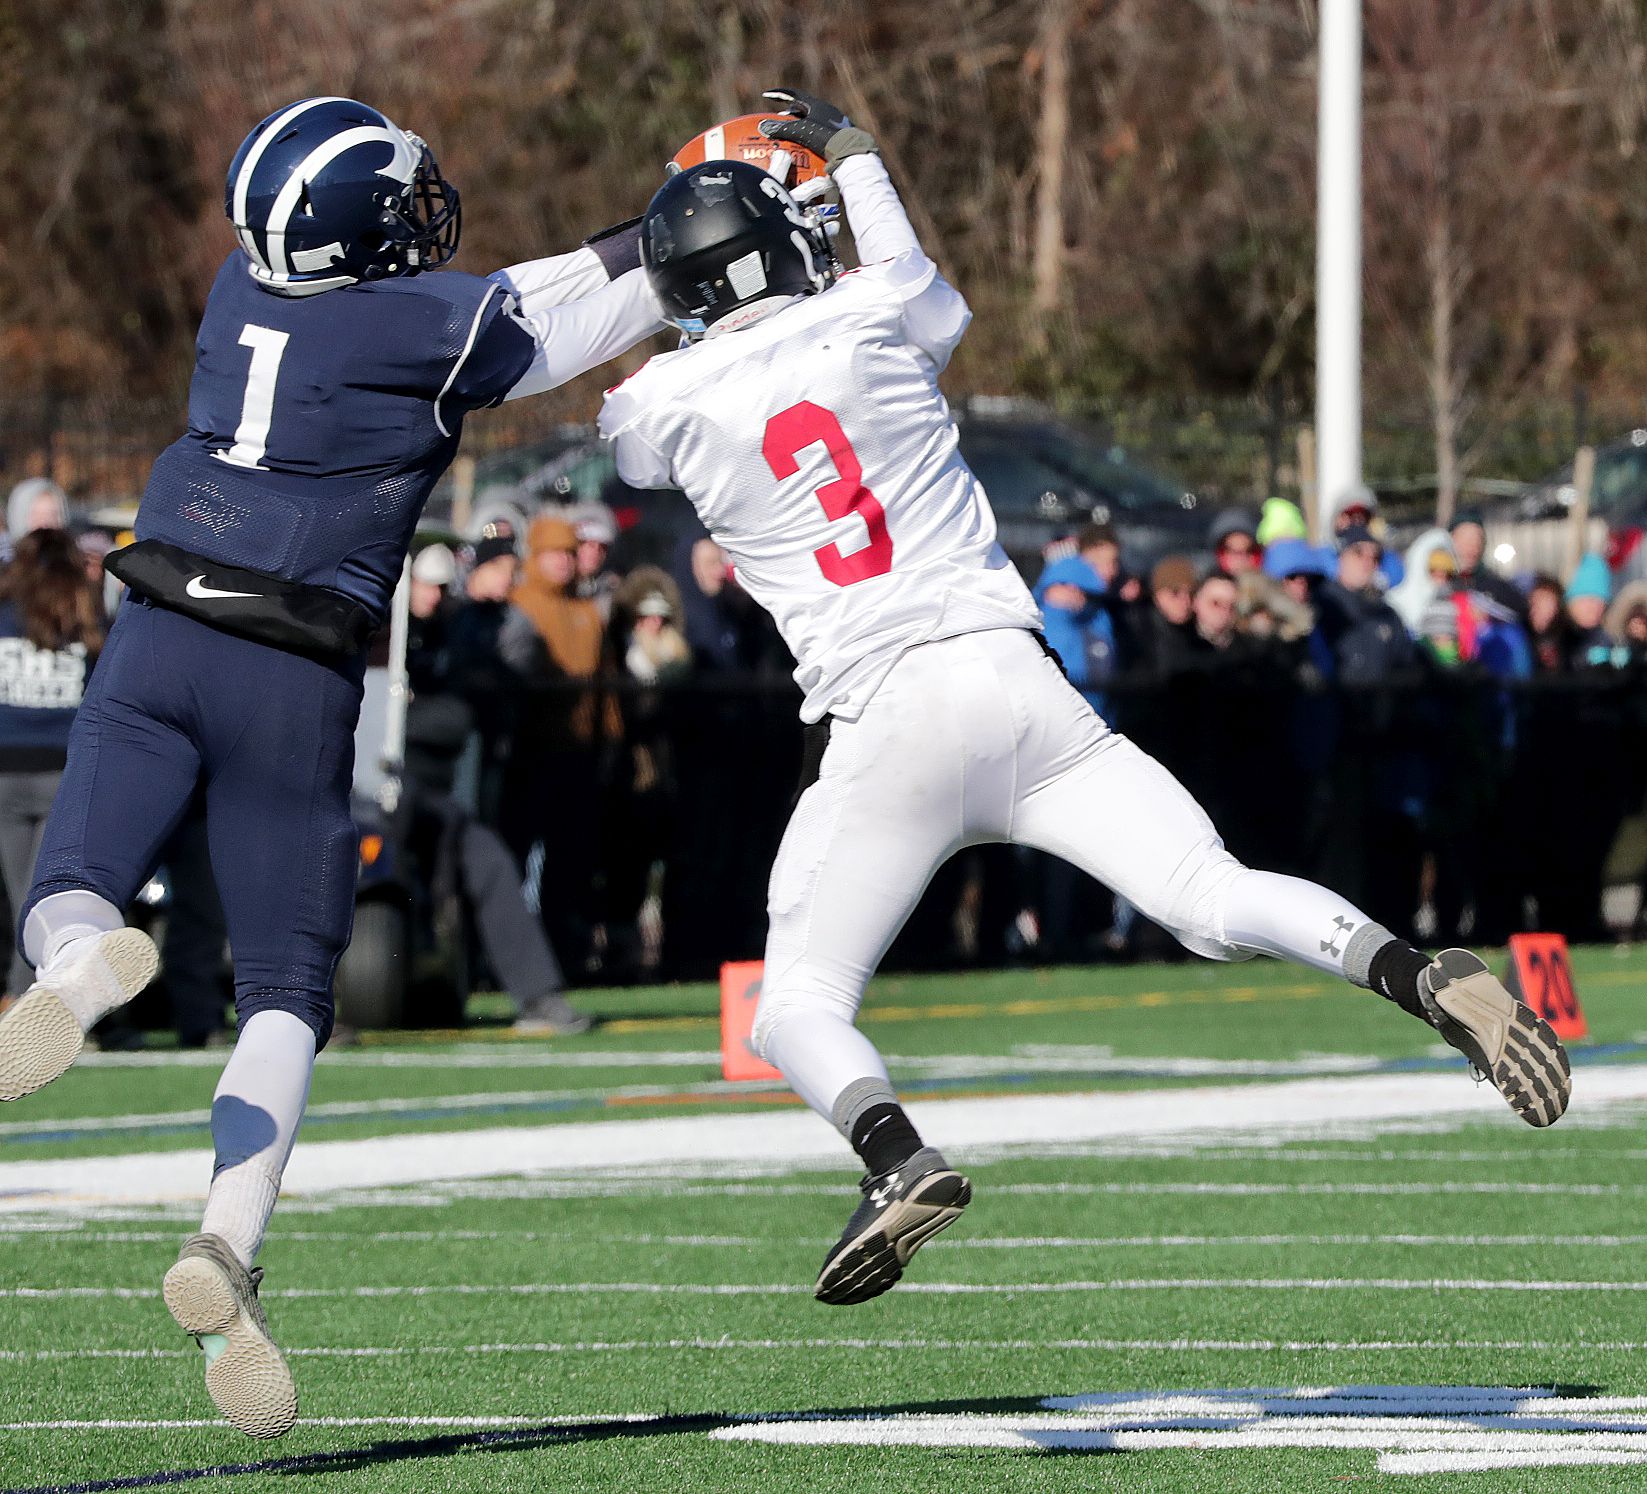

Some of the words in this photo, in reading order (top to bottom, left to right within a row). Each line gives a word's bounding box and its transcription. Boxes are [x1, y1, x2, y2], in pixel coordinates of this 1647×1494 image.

[759, 177, 806, 229] 3
[210, 323, 290, 471] 1
[762, 400, 893, 587] 3
[1528, 949, 1578, 1021] 20
